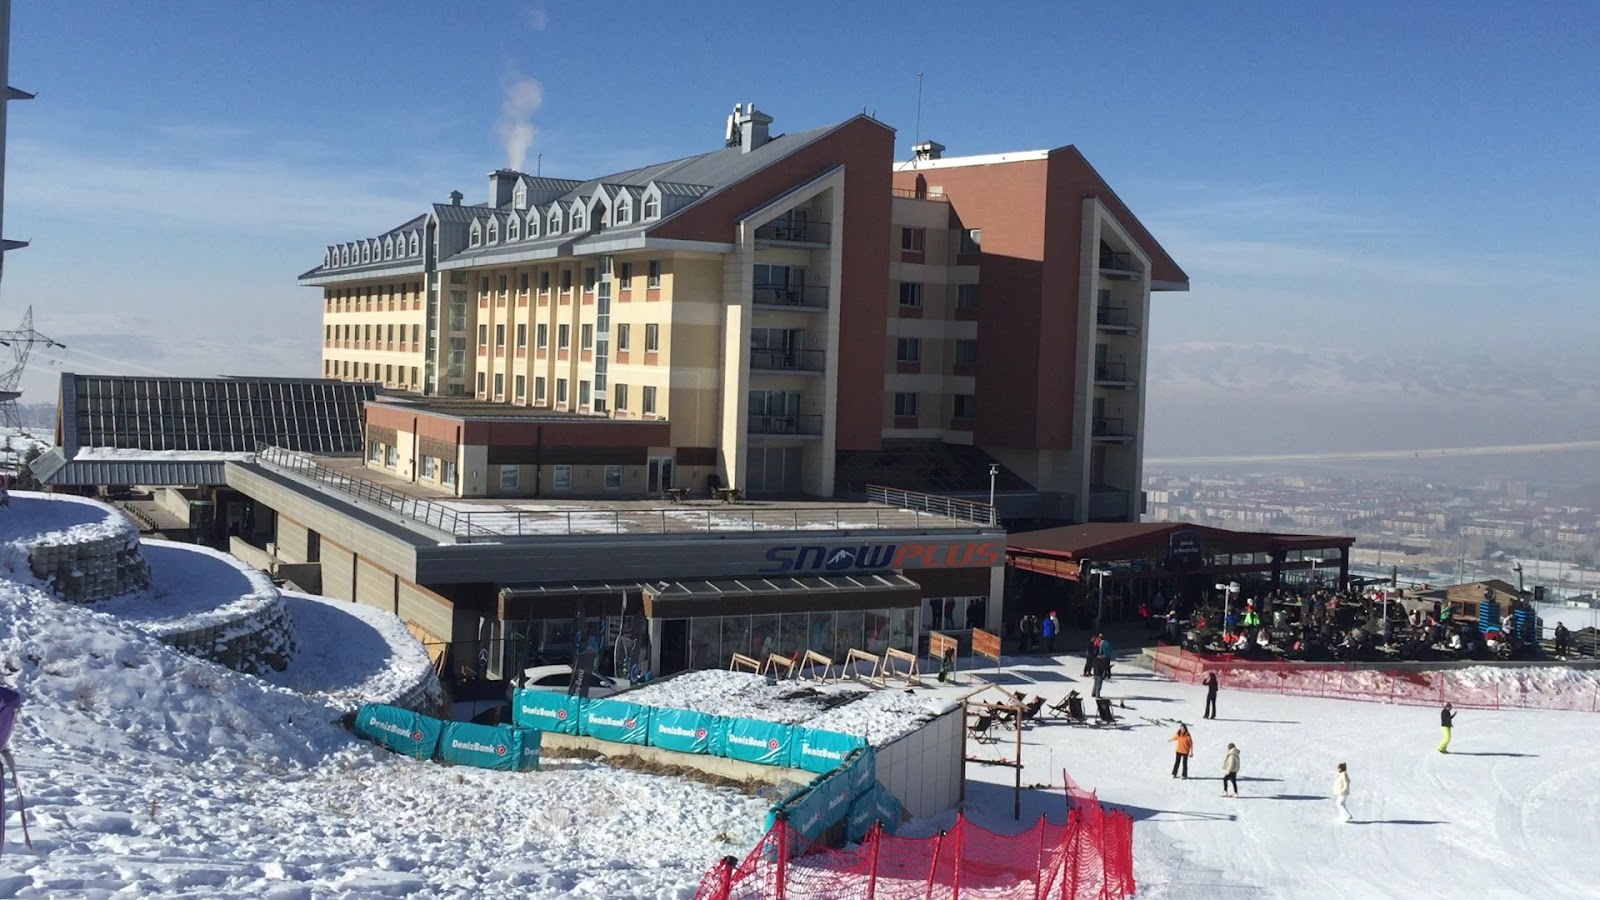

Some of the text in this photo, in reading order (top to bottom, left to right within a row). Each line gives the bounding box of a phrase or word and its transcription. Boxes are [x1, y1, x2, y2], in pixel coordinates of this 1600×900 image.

[522, 705, 557, 718] DenizBank
[369, 716, 412, 738] DenizBank
[588, 712, 624, 727] DenizBank
[658, 724, 696, 737] DenizBank
[452, 739, 495, 753] DenizBank
[729, 733, 767, 748] DenizBank
[802, 743, 841, 759] DenizBank
